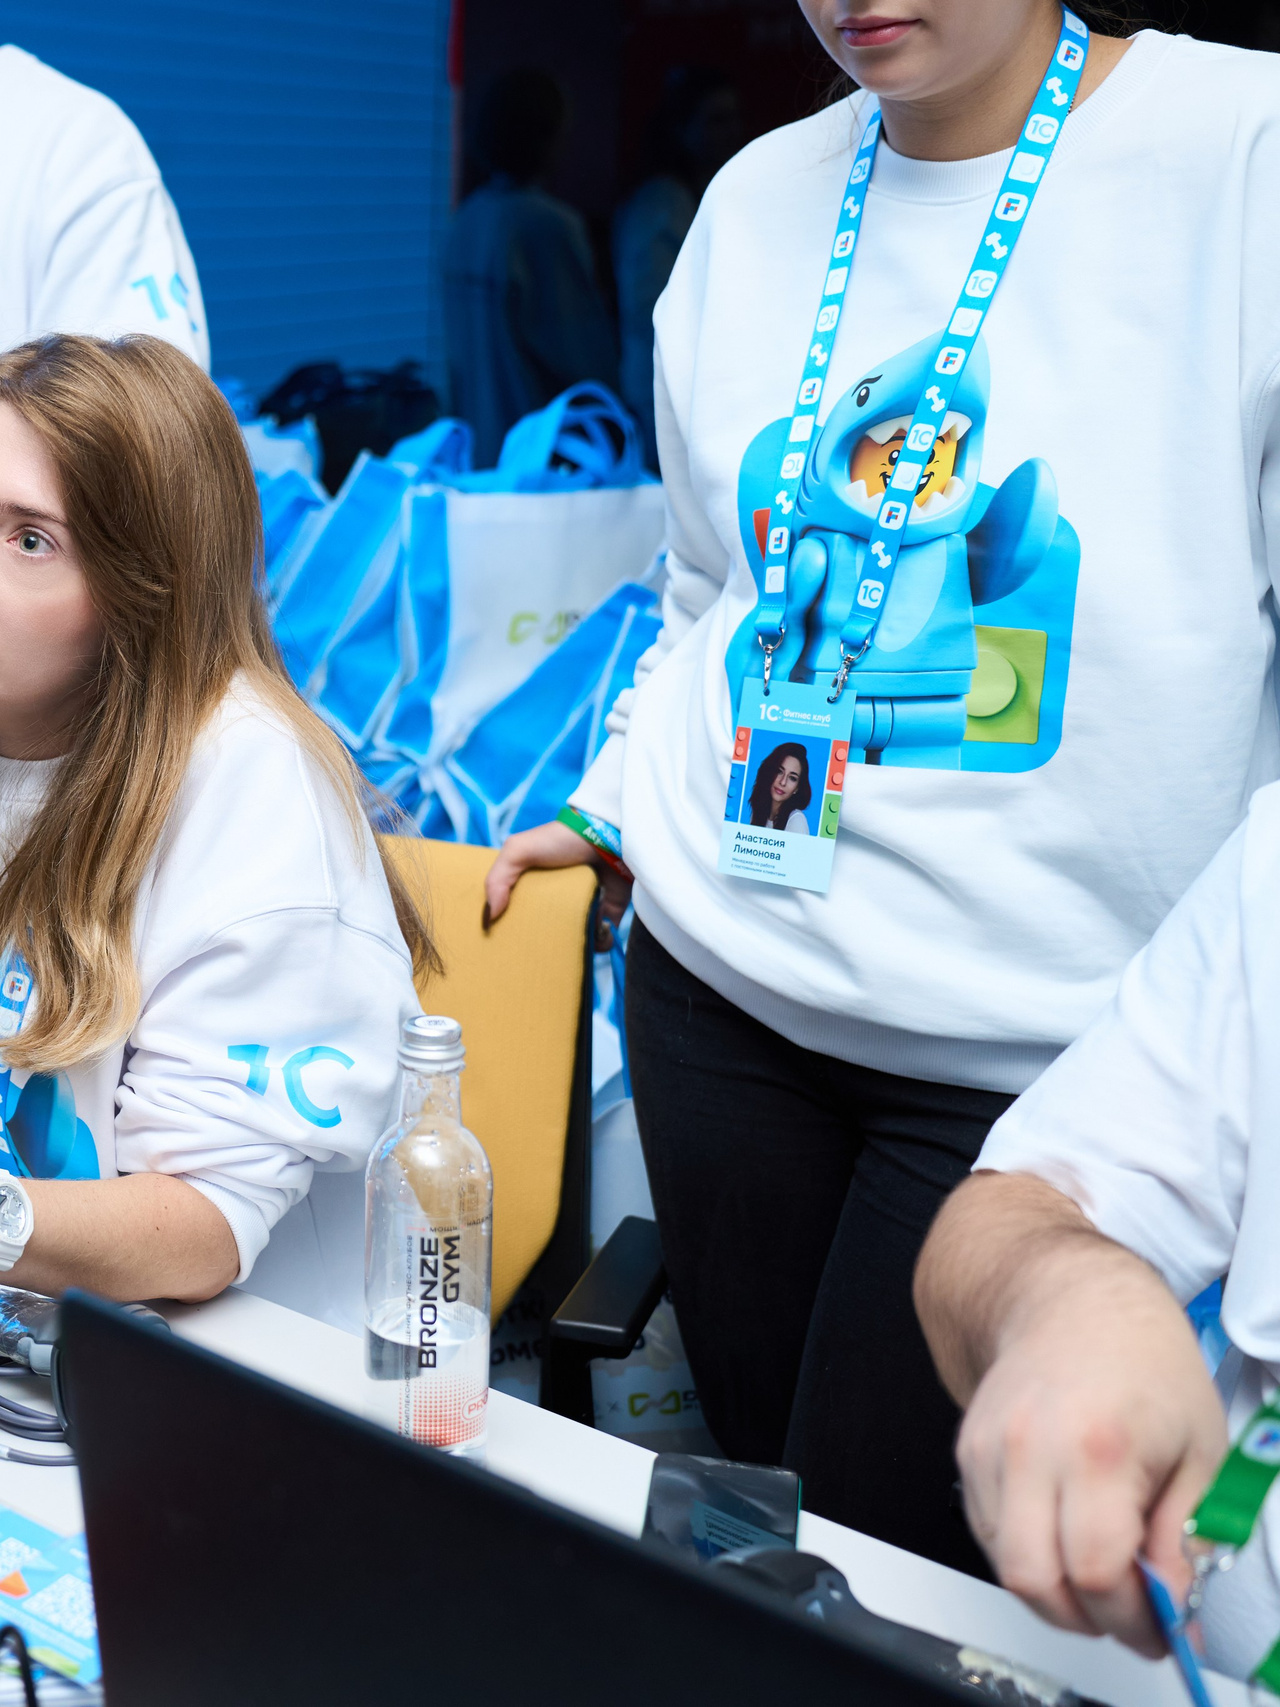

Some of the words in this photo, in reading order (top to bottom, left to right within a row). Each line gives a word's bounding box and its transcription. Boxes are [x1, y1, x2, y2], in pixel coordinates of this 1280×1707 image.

[783, 709, 811, 720] Фитнес
[812, 714, 831, 724] клуб
[735, 831, 785, 848] Анастасия
[733, 844, 781, 861] Лимонова
[442, 1234, 461, 1304] GYM
[418, 1236, 438, 1368] BRONZE
